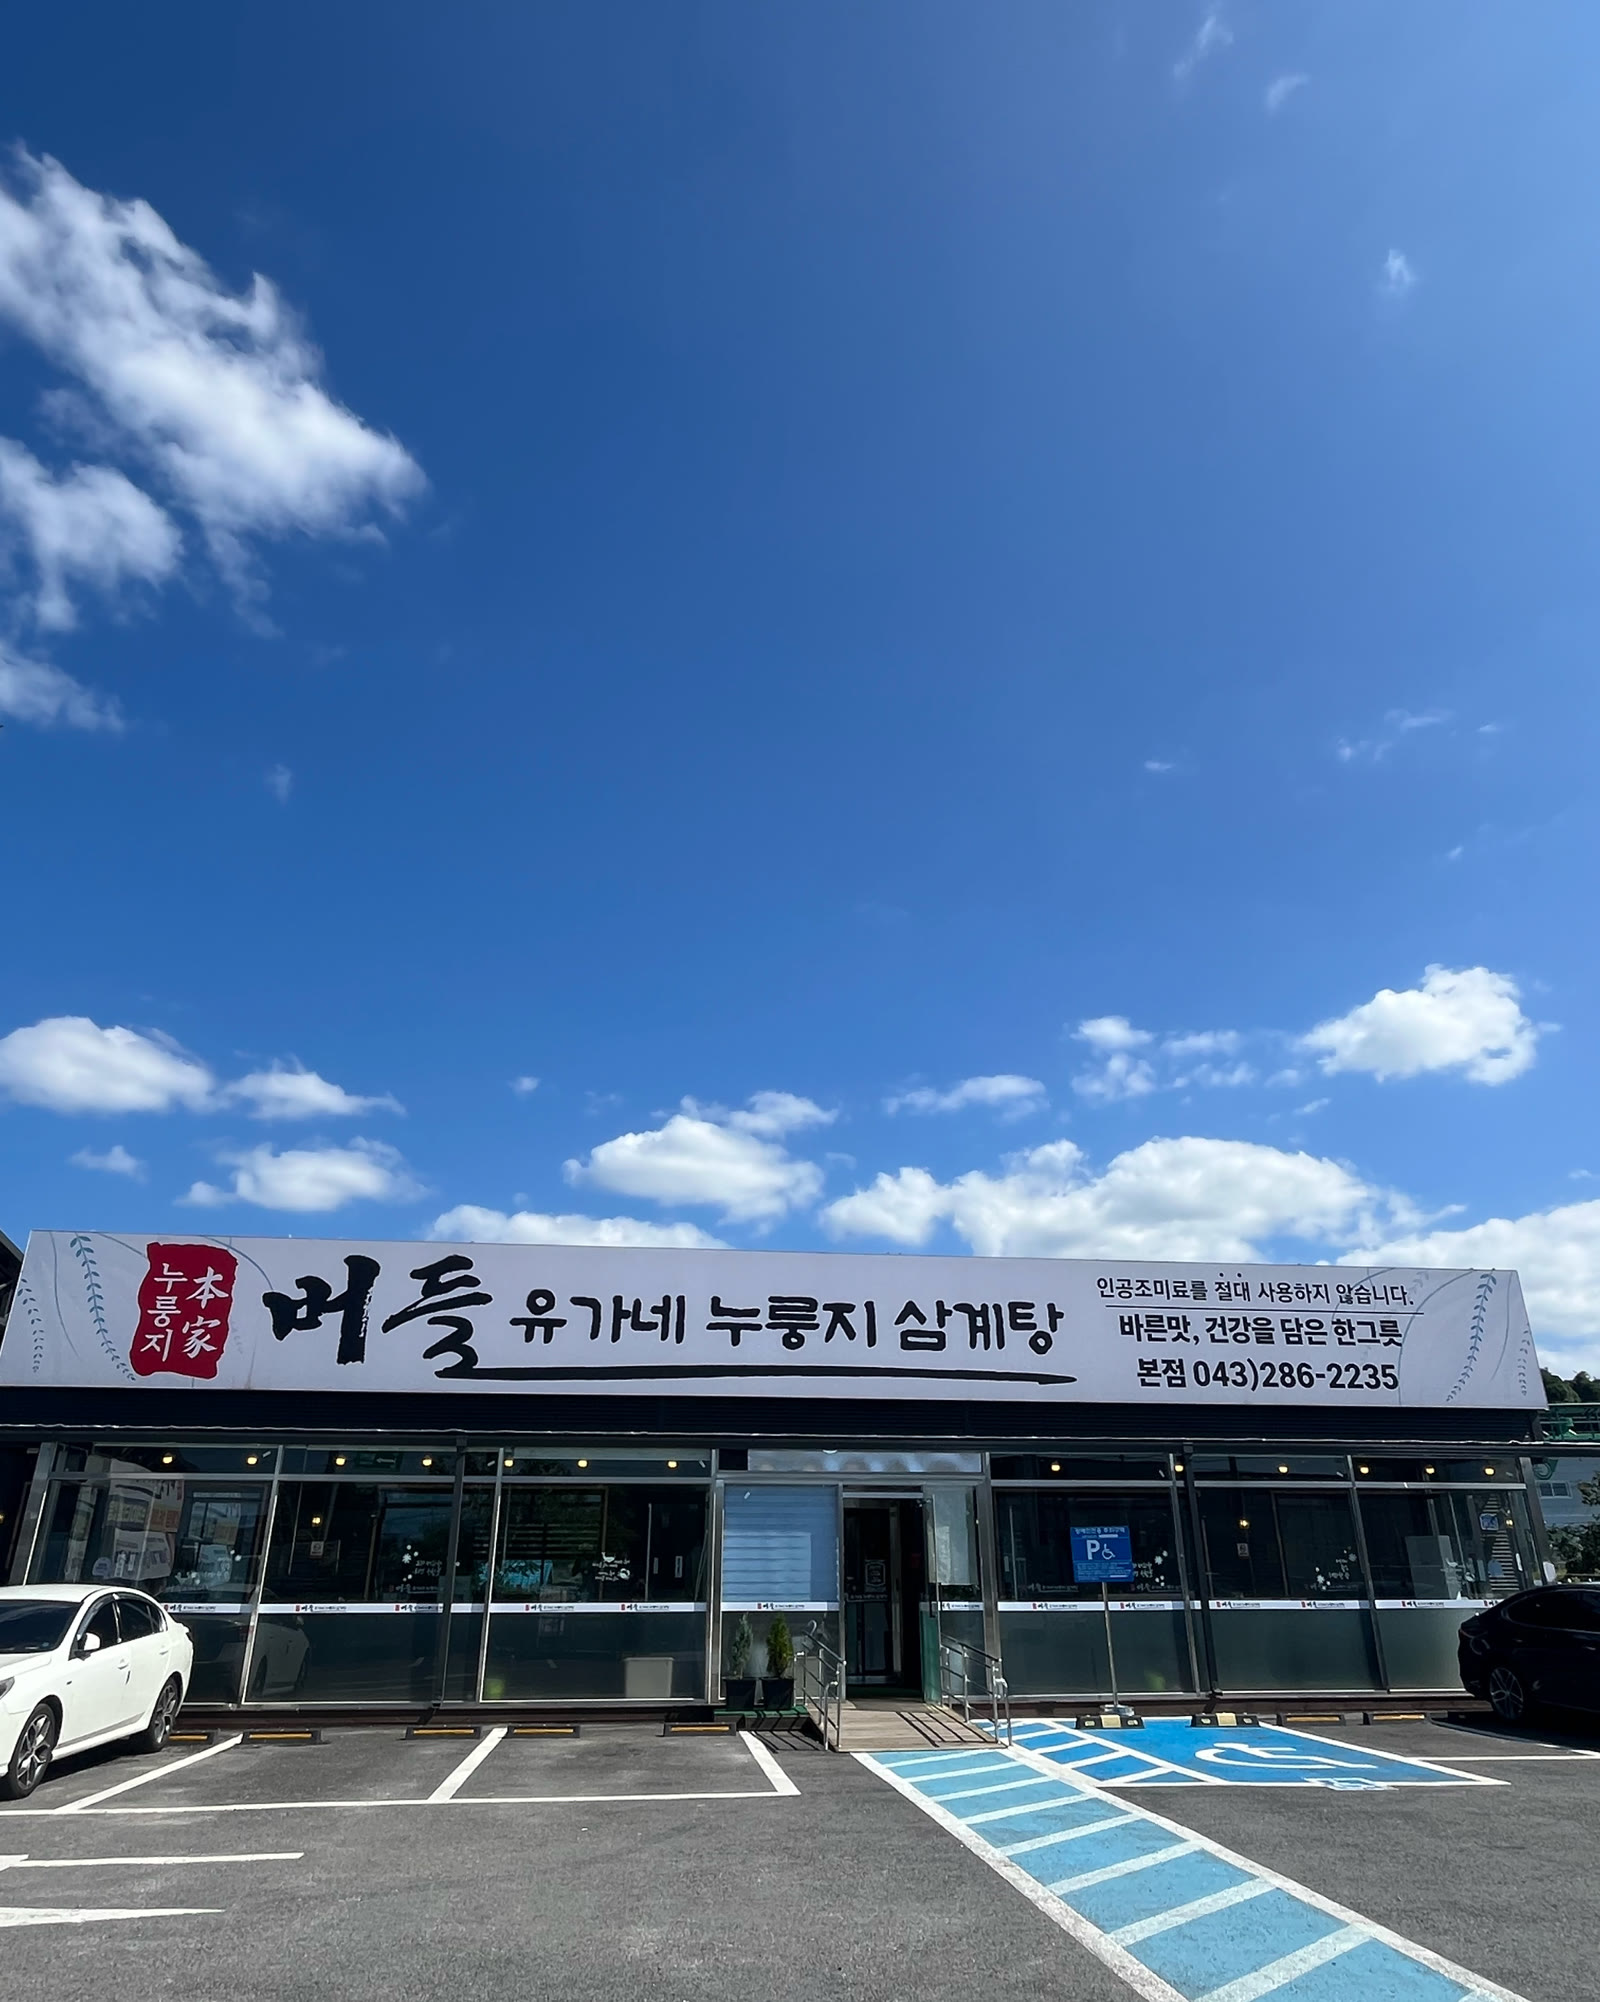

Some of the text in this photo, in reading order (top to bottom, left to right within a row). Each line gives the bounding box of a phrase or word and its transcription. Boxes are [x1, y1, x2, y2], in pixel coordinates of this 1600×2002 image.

[1096, 1276, 1414, 1306] 인공조미료를 절대 사용하지 않습니다.
[182, 1265, 229, 1359] 本家
[510, 1288, 686, 1344] 유가네
[705, 1295, 877, 1351] 누룽지
[894, 1299, 1064, 1355] 삼계탕
[1118, 1313, 1403, 1347] 바른맛, 건강을 담은 한그릇
[1136, 1357, 1399, 1392] 본점 043)286-2235
[1086, 1539, 1101, 1560] P
